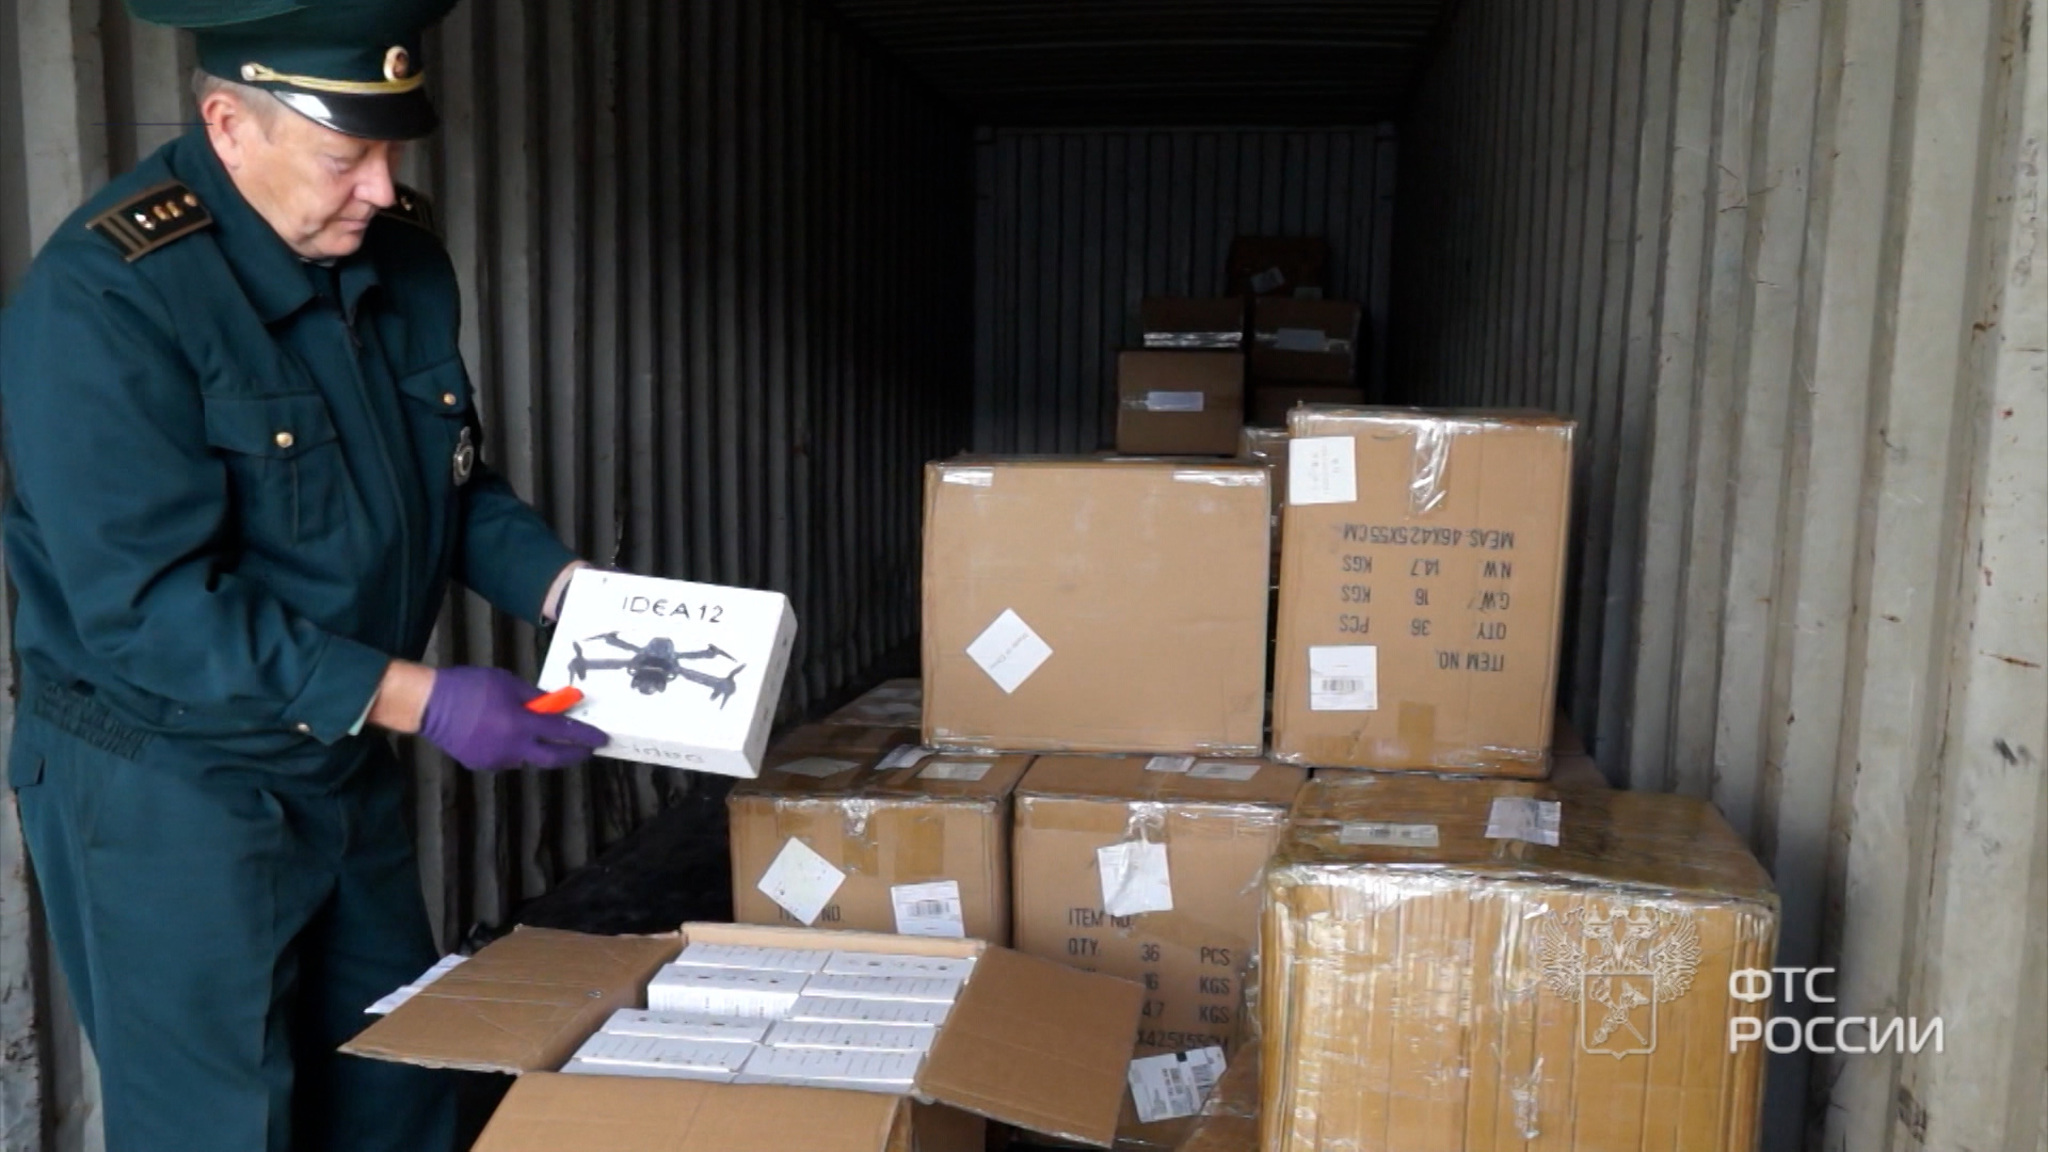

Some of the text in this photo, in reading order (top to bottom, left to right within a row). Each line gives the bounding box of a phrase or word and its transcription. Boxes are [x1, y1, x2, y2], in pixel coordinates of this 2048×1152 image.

[1342, 555, 1373, 573] KGS
[1341, 585, 1372, 603] KGS
[1414, 588, 1430, 606] 16
[622, 595, 723, 623] IDEA 12
[1339, 614, 1370, 633] PCS
[1411, 618, 1432, 637] 36
[1467, 653, 1504, 672] ITEM
[1068, 908, 1103, 927] ITEM
[1141, 944, 1160, 962] 36
[1200, 946, 1231, 966] PCS
[1199, 976, 1230, 995] KGS
[1199, 1005, 1230, 1024] KGS
